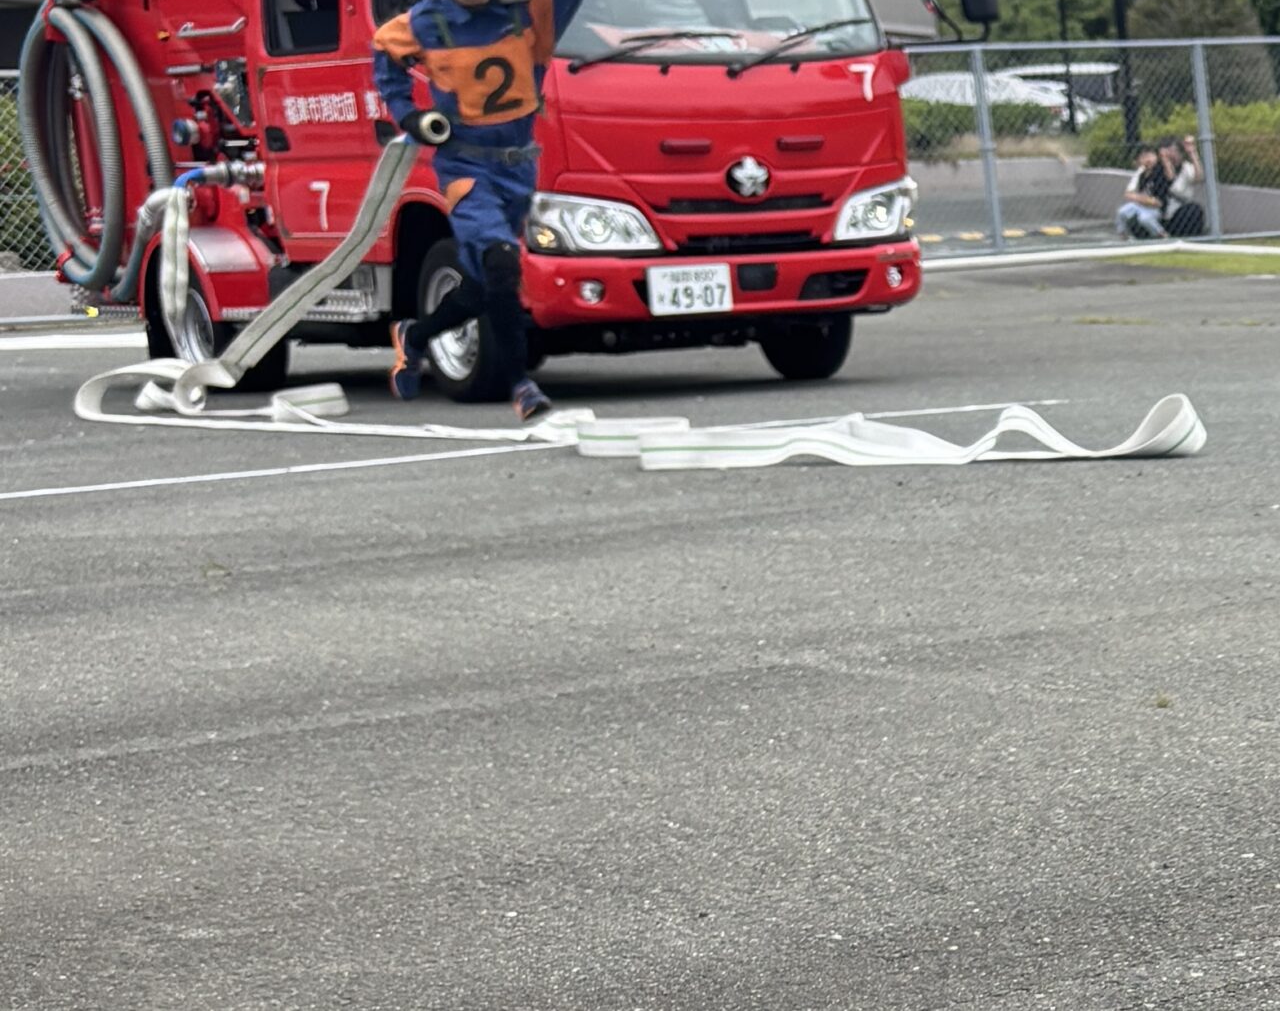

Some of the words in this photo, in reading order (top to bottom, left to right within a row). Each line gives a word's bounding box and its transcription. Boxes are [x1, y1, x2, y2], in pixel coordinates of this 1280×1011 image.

[474, 56, 524, 116] 2
[848, 62, 876, 102] 7
[309, 180, 331, 231] 7
[671, 283, 727, 309] 49-07
